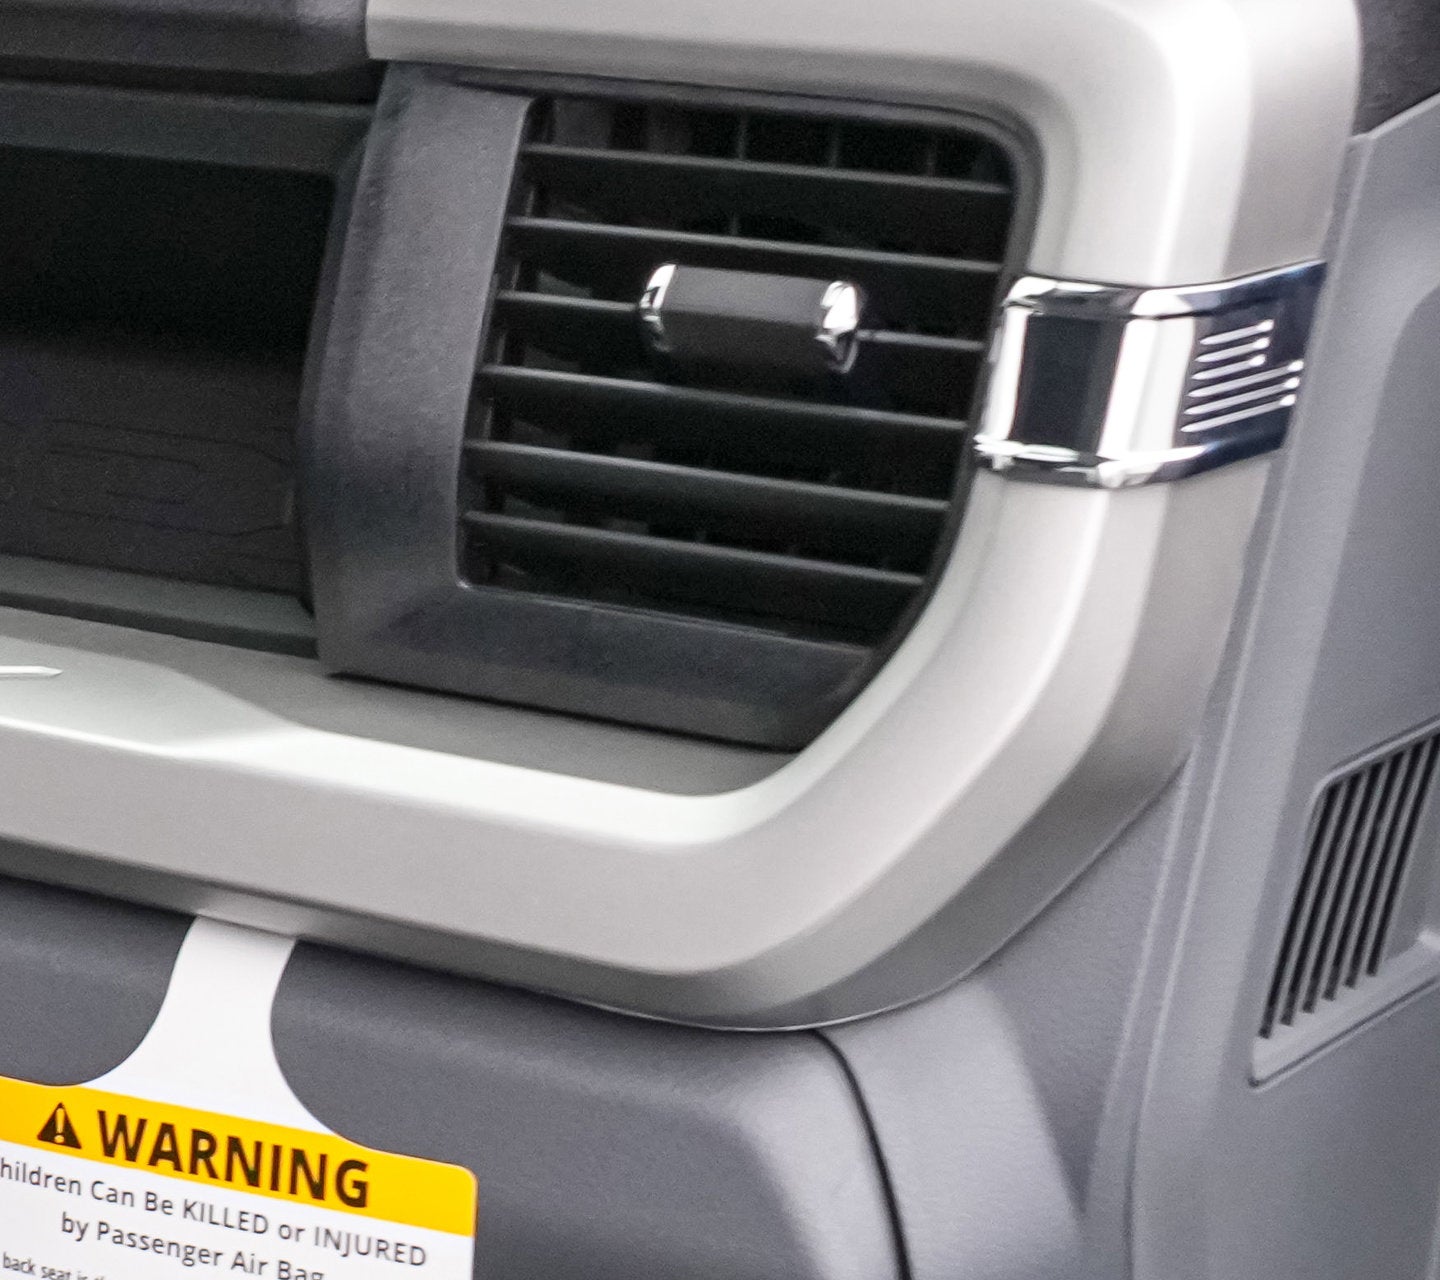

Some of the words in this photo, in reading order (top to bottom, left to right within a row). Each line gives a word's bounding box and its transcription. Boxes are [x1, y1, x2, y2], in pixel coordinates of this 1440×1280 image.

[97, 1109, 369, 1208] WARNING
[62, 1211, 89, 1242] by
[97, 1221, 224, 1267] Passenger
[231, 1251, 269, 1275] Air
[91, 1180, 135, 1207] Can
[145, 1191, 174, 1216] Be
[183, 1198, 269, 1234] KILLED
[278, 1223, 306, 1243] or
[314, 1226, 426, 1266] INJURED
[2, 1251, 37, 1276] back
